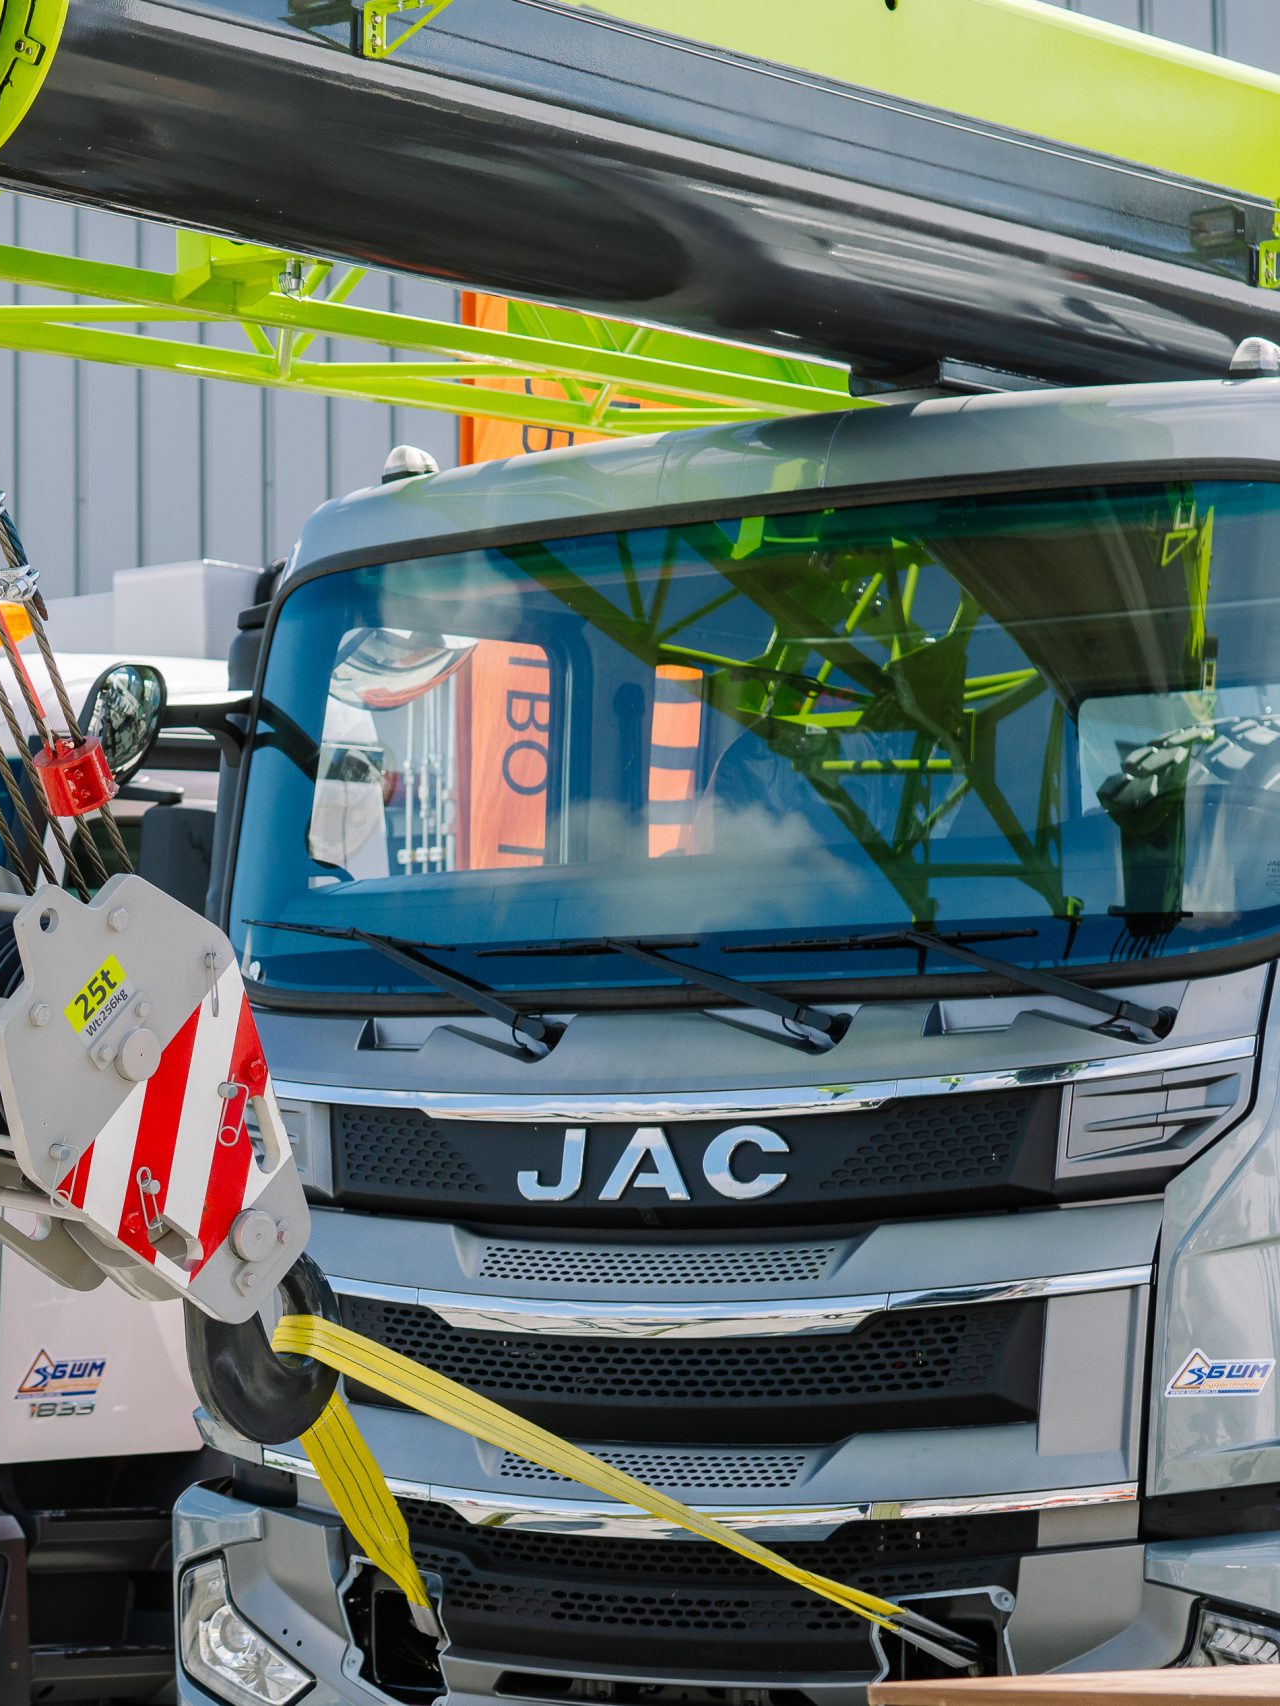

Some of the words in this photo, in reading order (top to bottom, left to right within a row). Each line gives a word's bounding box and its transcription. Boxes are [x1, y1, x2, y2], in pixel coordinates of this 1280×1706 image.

[74, 969, 118, 1022] 25t
[85, 988, 129, 1037] Wt:256kg
[516, 1124, 791, 1201] JAC
